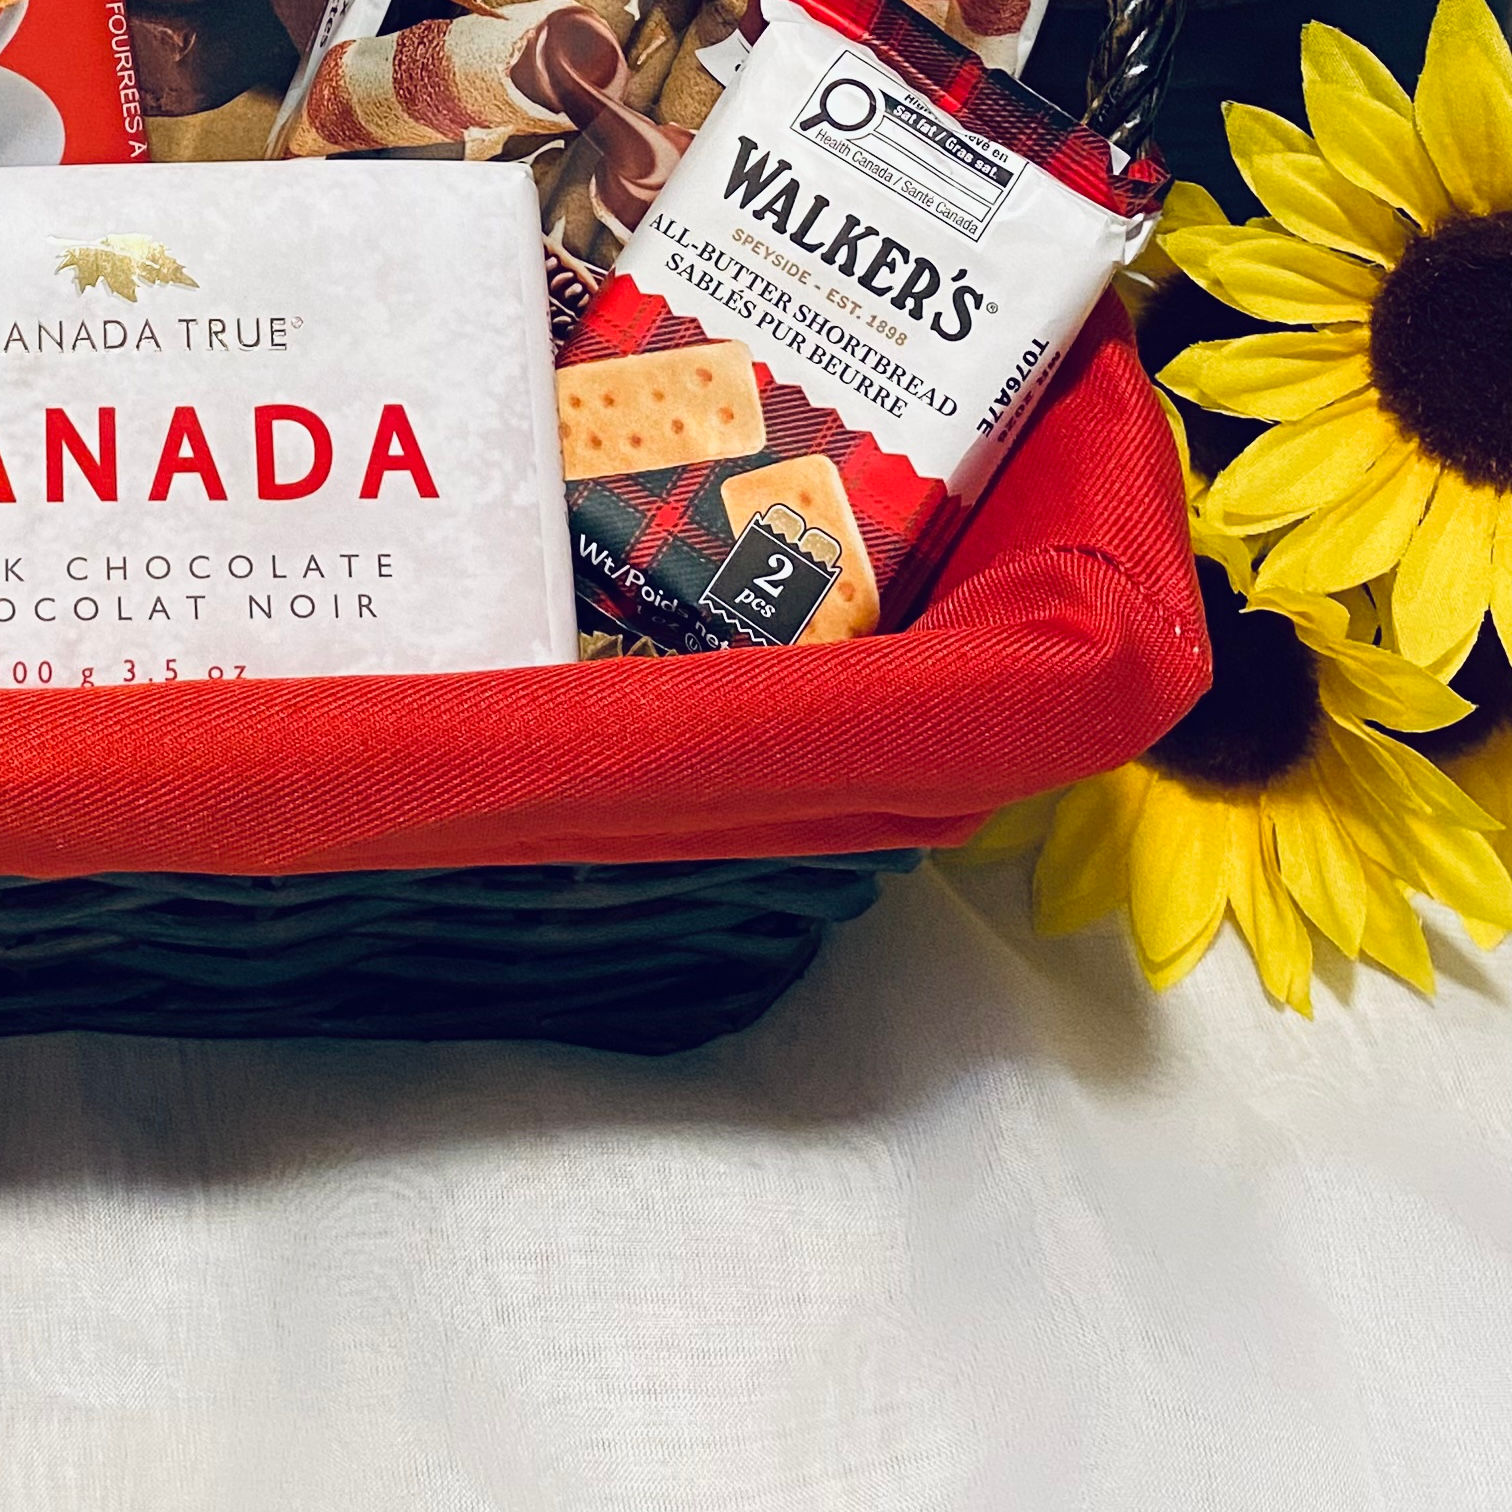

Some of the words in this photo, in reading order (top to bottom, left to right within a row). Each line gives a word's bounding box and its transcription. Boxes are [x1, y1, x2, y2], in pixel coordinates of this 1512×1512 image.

[945, 137, 974, 163] Gras
[815, 128, 850, 157] Health
[851, 150, 897, 186] Canada
[900, 180, 935, 208] Santé
[935, 200, 978, 235] Canada
[731, 227, 812, 286] SPEYSIDE
[825, 291, 864, 321] EST.
[865, 314, 909, 348] 1898
[649, 212, 792, 314] ALL-BUTTER
[792, 303, 958, 418] SHORTBREAD
[665, 252, 758, 320] SABLÉS
[755, 310, 807, 356] PUR
[806, 342, 909, 419] BEURRE
[976, 338, 1050, 438] T076A7E
[66, 553, 394, 582] CHOCOLATE
[753, 553, 795, 599] 2
[249, 593, 379, 620] NOIR
[734, 587, 778, 619] pcs
[80, 666, 95, 688] g
[123, 659, 178, 682] 3.5
[207, 664, 247, 681] oz
